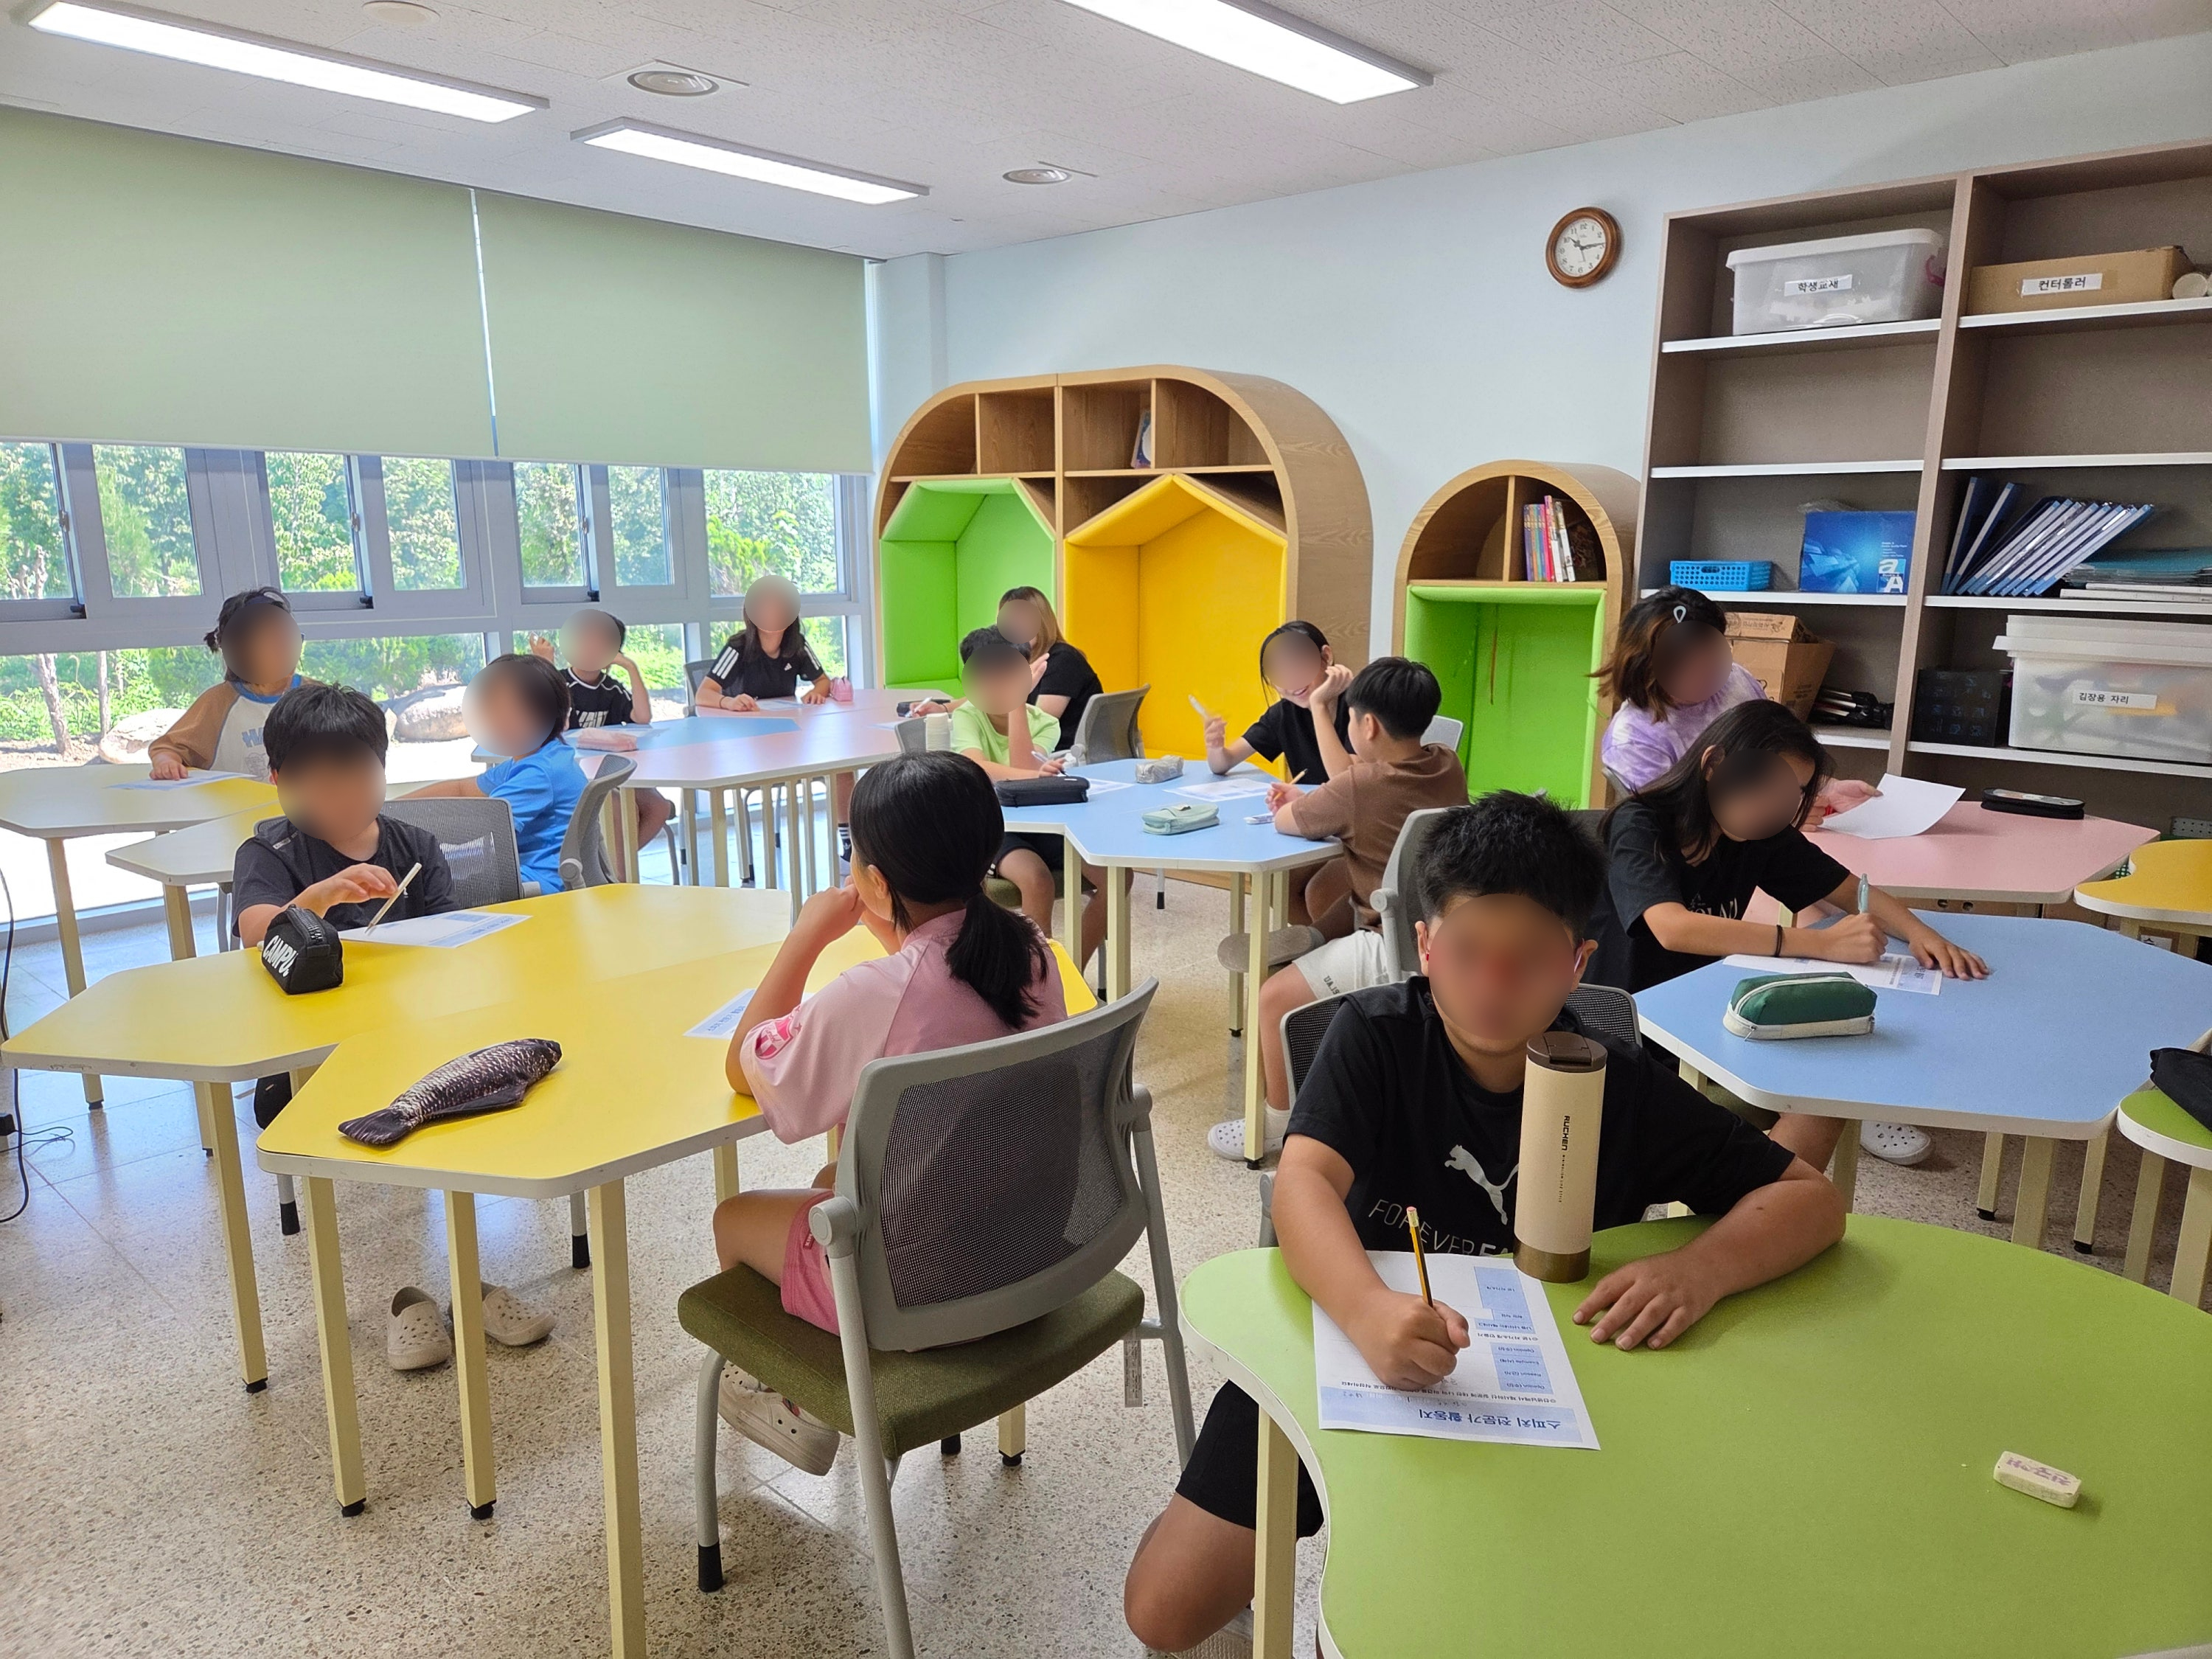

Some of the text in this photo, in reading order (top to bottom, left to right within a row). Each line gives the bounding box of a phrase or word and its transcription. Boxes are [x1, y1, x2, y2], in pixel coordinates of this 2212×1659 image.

[1798, 279, 1839, 293] 학생교재
[2079, 692, 2129, 705] 김장용 자리
[262, 935, 299, 978] CAMPU
[1419, 1408, 1561, 1429] 스피치 전문가 활동지
